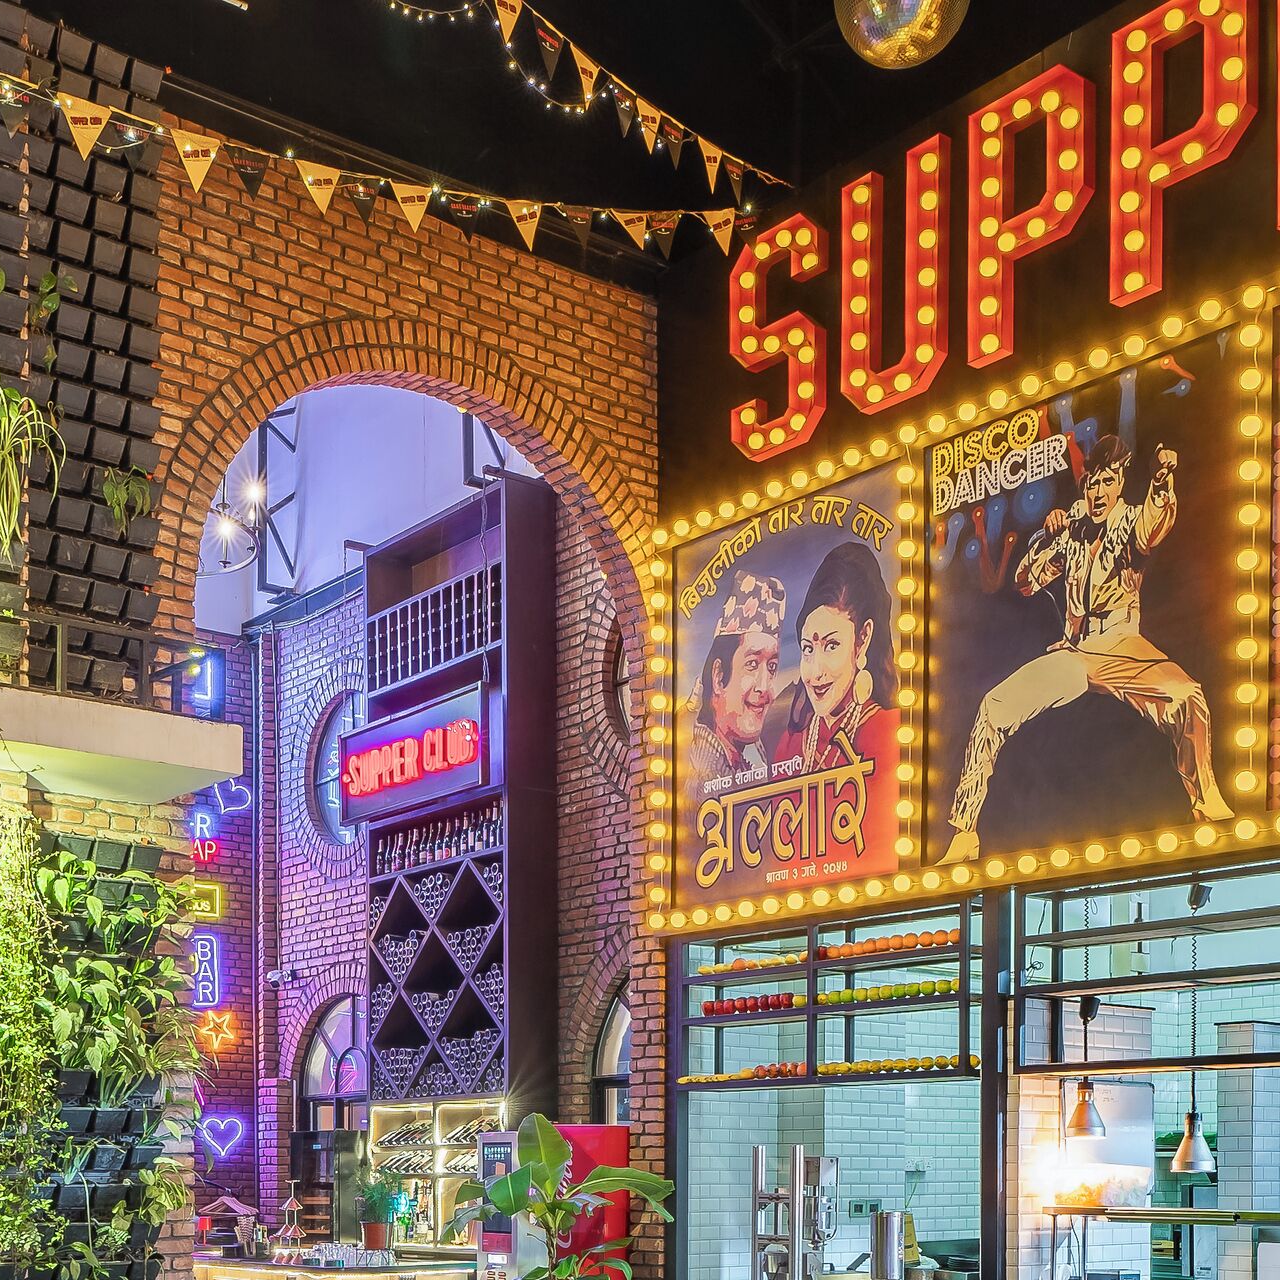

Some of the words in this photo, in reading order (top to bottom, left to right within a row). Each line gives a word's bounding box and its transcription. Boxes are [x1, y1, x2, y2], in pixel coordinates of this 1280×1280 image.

[932, 408, 1039, 478] DISCO
[933, 434, 1068, 516] DANCER
[679, 517, 763, 620] बिजुलीको
[767, 498, 806, 534] तार
[810, 495, 852, 527] तार
[851, 502, 894, 551] तार
[348, 737, 419, 796] SUPPER
[422, 720, 476, 772] CLUB
[703, 774, 732, 793] अशोक
[197, 940, 213, 1002] BAR
